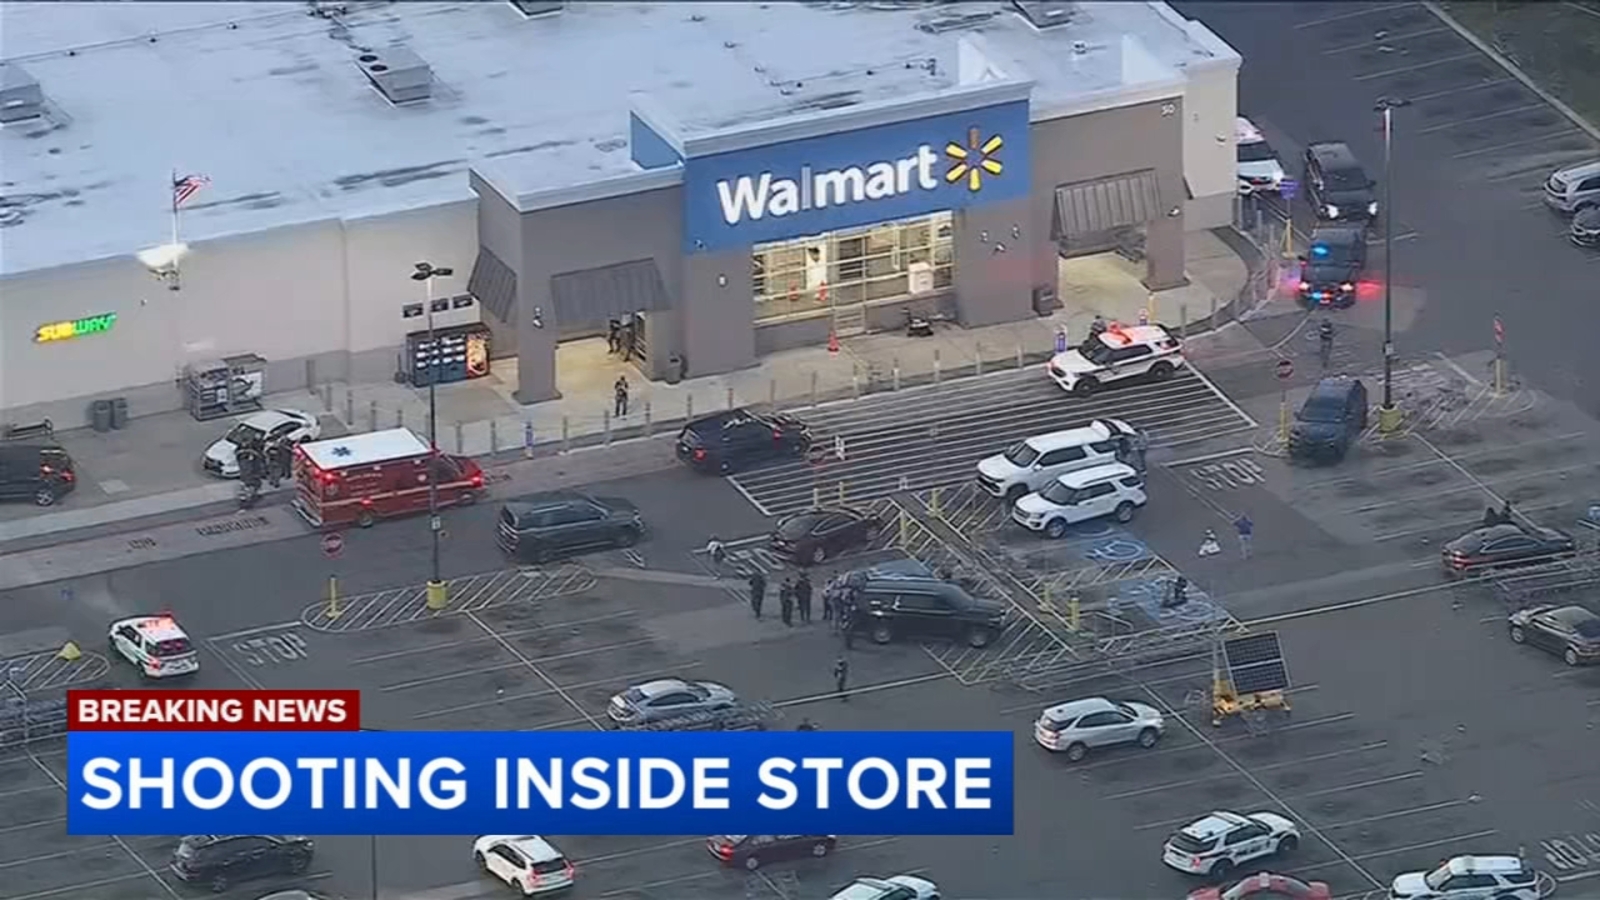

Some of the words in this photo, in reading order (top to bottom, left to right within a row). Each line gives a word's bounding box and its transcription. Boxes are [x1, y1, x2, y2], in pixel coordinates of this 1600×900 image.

[716, 144, 938, 225] Walmart
[36, 313, 117, 342] SUBWAY
[1189, 458, 1266, 491] STOP
[723, 548, 786, 576] STO
[232, 632, 308, 666] STOP
